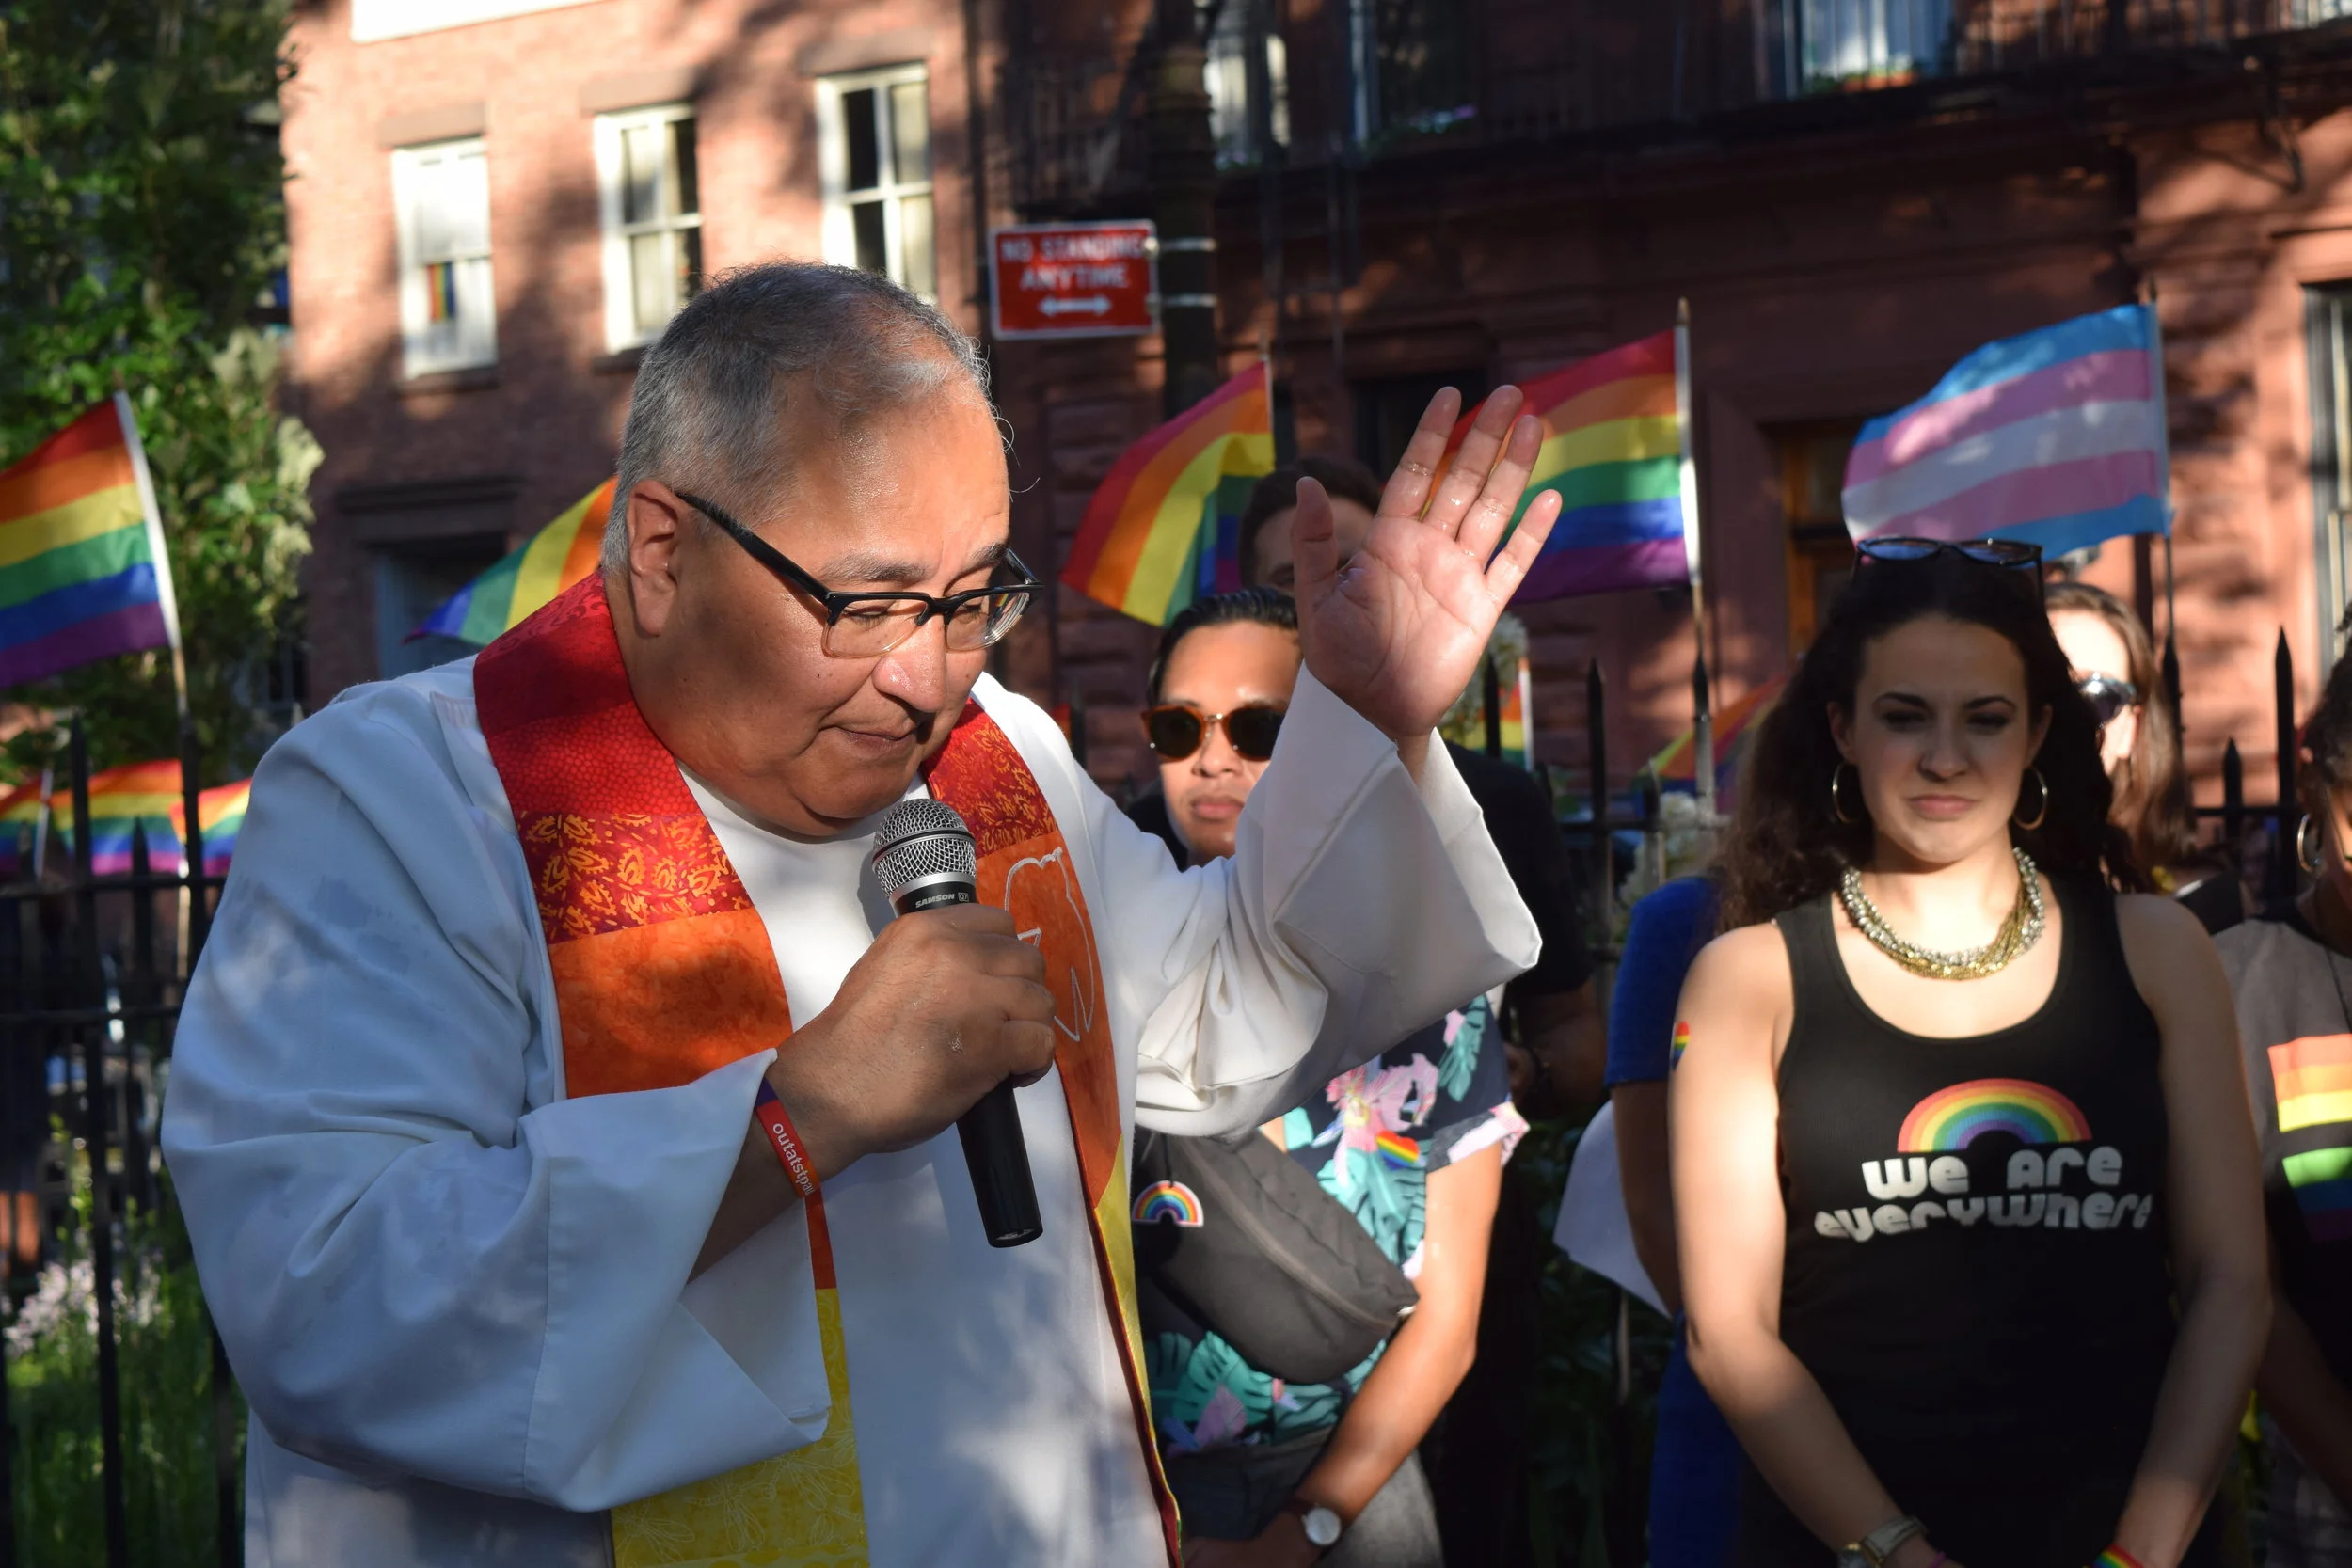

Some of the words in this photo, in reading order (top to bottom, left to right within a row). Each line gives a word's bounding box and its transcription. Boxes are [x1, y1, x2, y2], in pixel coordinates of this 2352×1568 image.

[1001, 238, 1033, 262] NO
[1041, 232, 1142, 261] STANDING
[1019, 263, 1129, 291] ANYTIME
[915, 894, 955, 908] SAMSON
